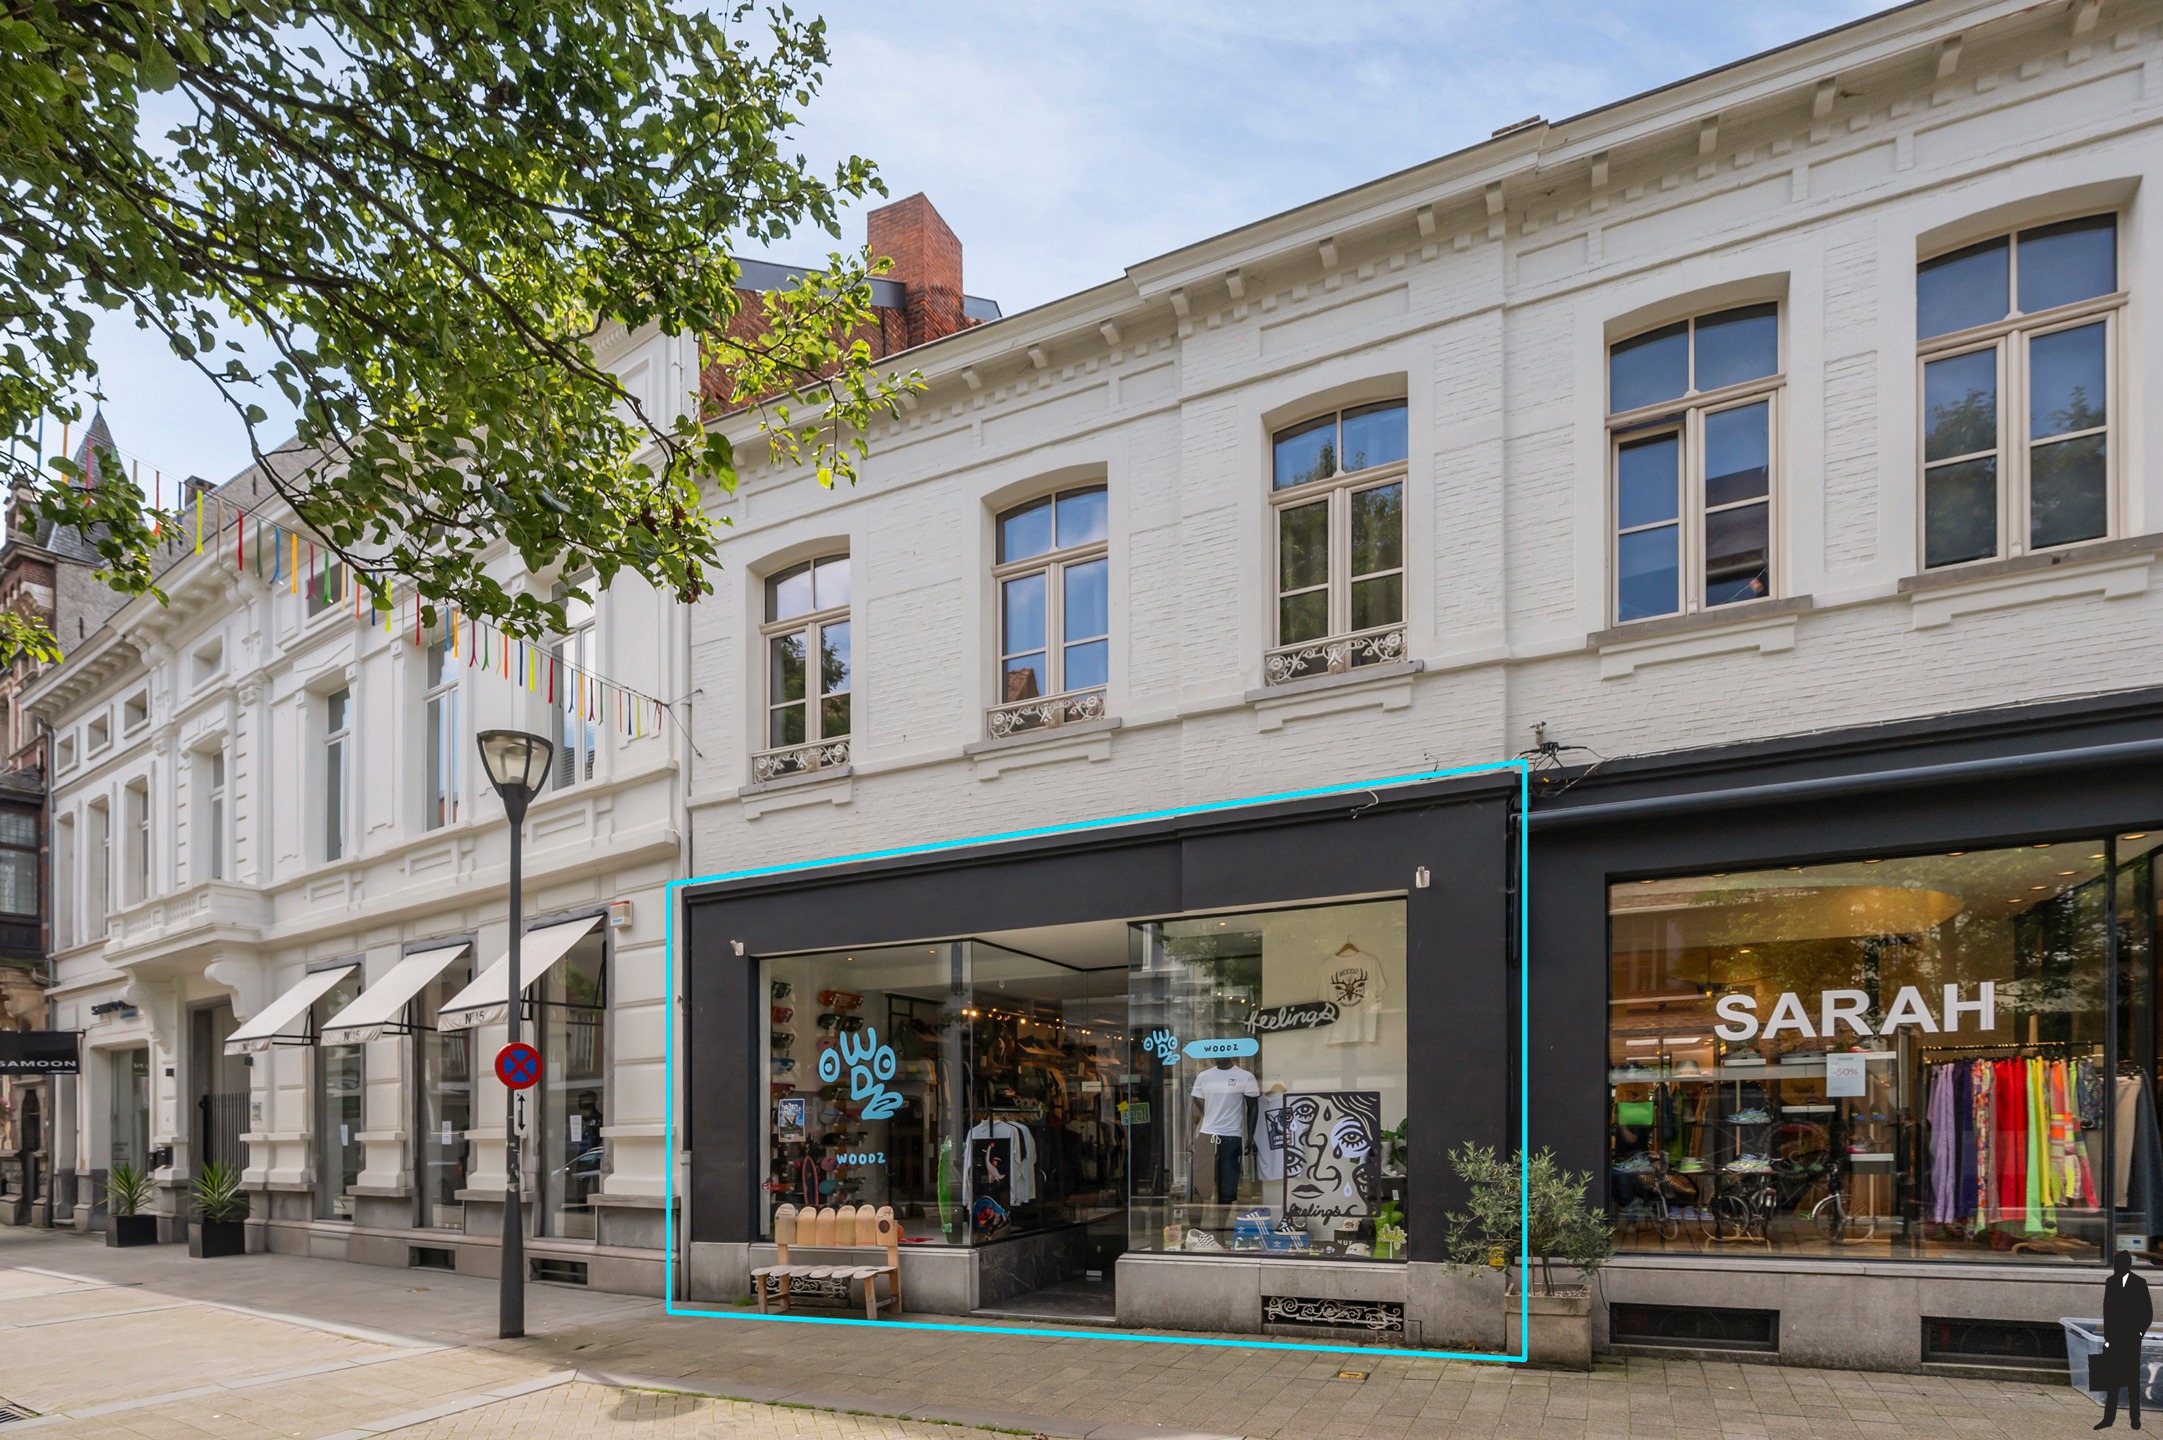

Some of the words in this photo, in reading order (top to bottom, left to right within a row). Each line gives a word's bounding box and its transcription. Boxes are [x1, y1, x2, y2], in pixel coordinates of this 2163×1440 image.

[1242, 1001, 1337, 1034] feelings
[1714, 981, 1995, 1041] SARAH
[1203, 1043, 1239, 1053] WOODZ
[1832, 1067, 1860, 1077] -50%
[836, 1152, 886, 1165] WOODZ
